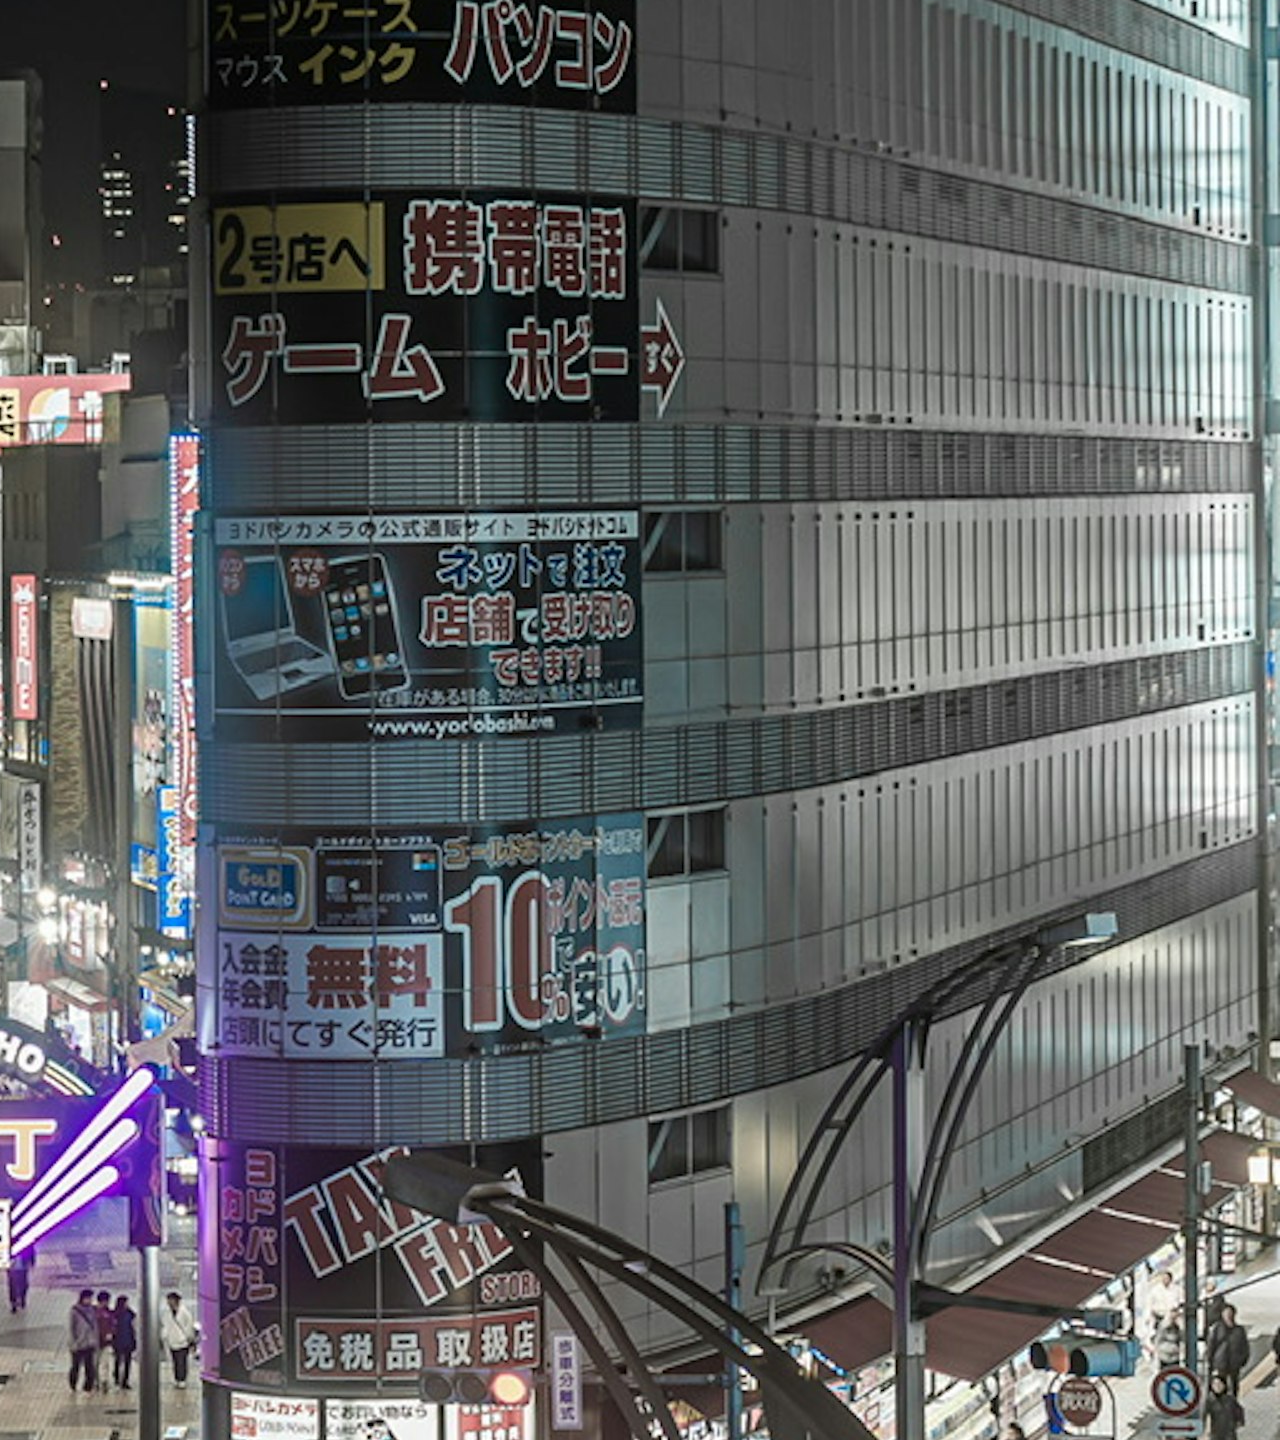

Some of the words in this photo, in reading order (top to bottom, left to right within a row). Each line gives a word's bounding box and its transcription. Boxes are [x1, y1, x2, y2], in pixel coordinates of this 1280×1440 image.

[216, 54, 288, 89] マウス
[299, 43, 416, 85] インク
[218, 214, 371, 288] 2号店へ
[403, 200, 627, 300] 携帯電話
[222, 312, 447, 406] ゲーム
[506, 314, 629, 402] ホビー
[289, 557, 326, 573] スマホ
[435, 544, 627, 588] ネットで注文
[418, 592, 636, 647] 店舗で受け取り
[220, 942, 288, 977] 入会金
[307, 944, 431, 1008] 無料
[443, 869, 557, 1032] 10
[220, 979, 288, 1012] 年会費
[220, 1018, 437, 1049] 店頭にてすぐ発行
[221, 1187, 245, 1301] カメラ
[245, 1149, 279, 1303] ヨドバシ
[302, 1319, 535, 1372] 免税品取扱店
[557, 1339, 577, 1421] 歩車分離式
